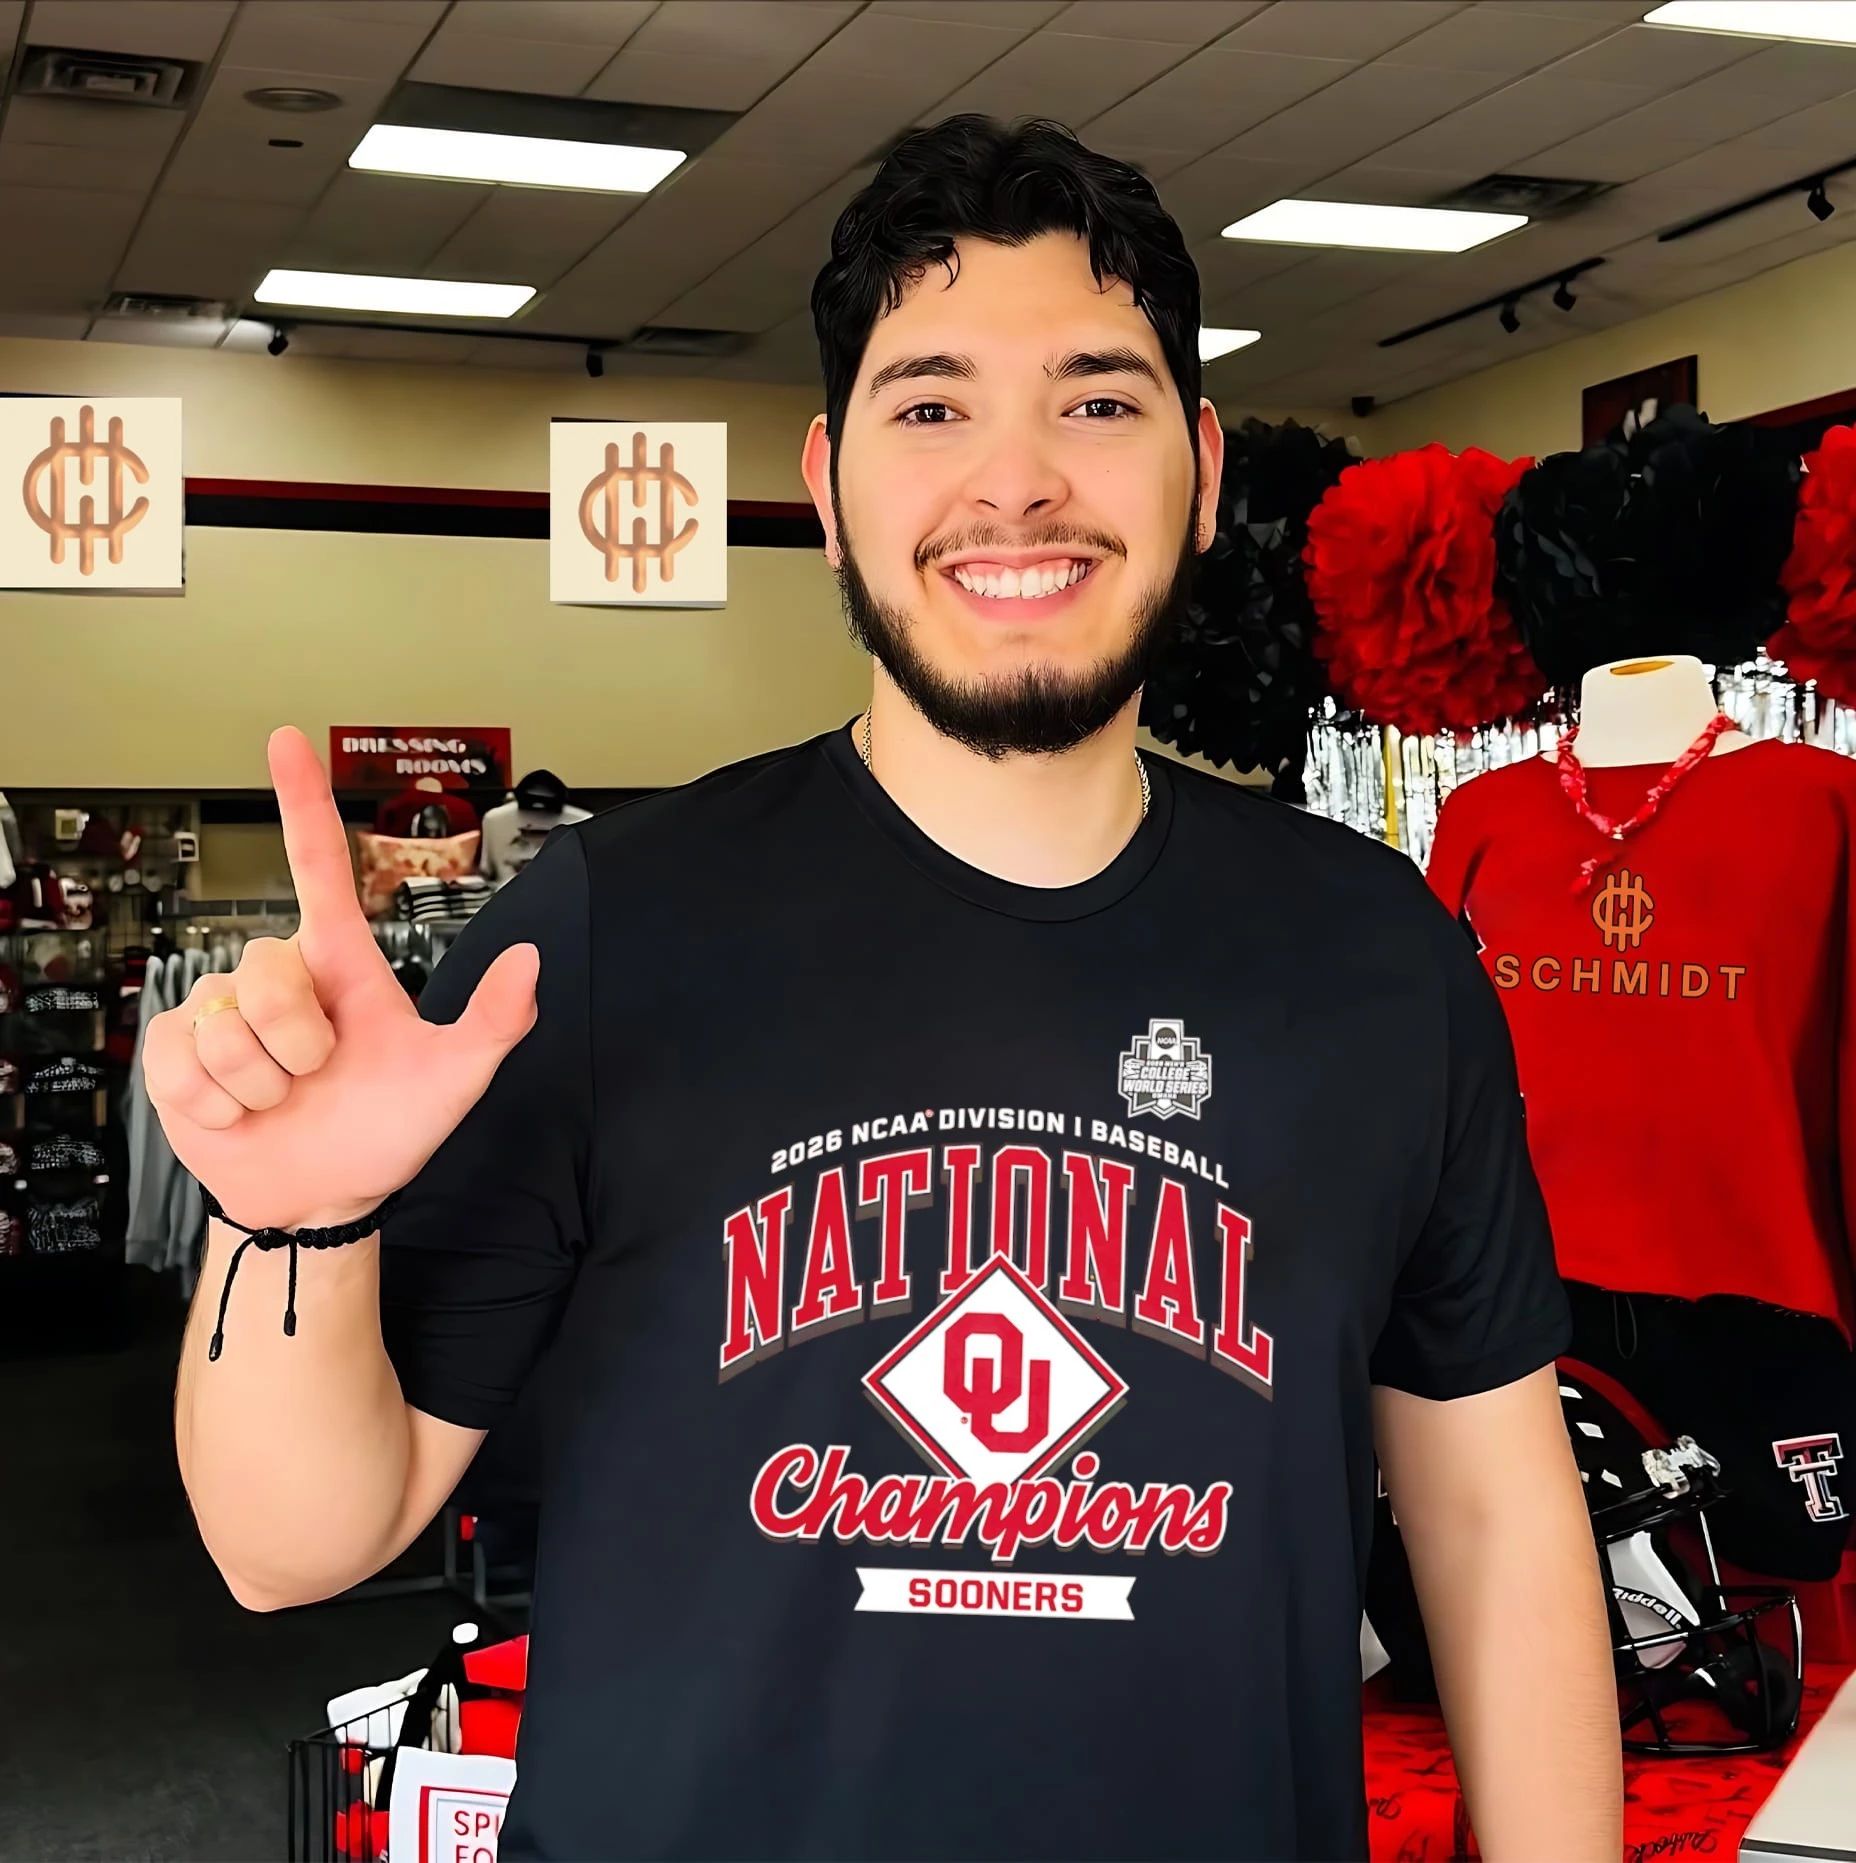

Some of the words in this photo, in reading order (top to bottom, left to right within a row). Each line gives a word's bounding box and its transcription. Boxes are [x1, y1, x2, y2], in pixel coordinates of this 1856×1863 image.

[396, 758, 487, 774] ROOMS
[1494, 955, 1746, 999] SCHMIDT
[1123, 1079, 1165, 1092] WORLD
[1165, 1081, 1207, 1095] SERIES
[1141, 1066, 1191, 1080] COLLEGE
[770, 1129, 843, 1174] 2026
[938, 1107, 1065, 1135] DIVISION
[1091, 1119, 1229, 1189] BASEBALL
[719, 1145, 1274, 1388] NATIONAL
[750, 1443, 1233, 1562] Champions
[908, 1577, 1084, 1613] SOONERS
